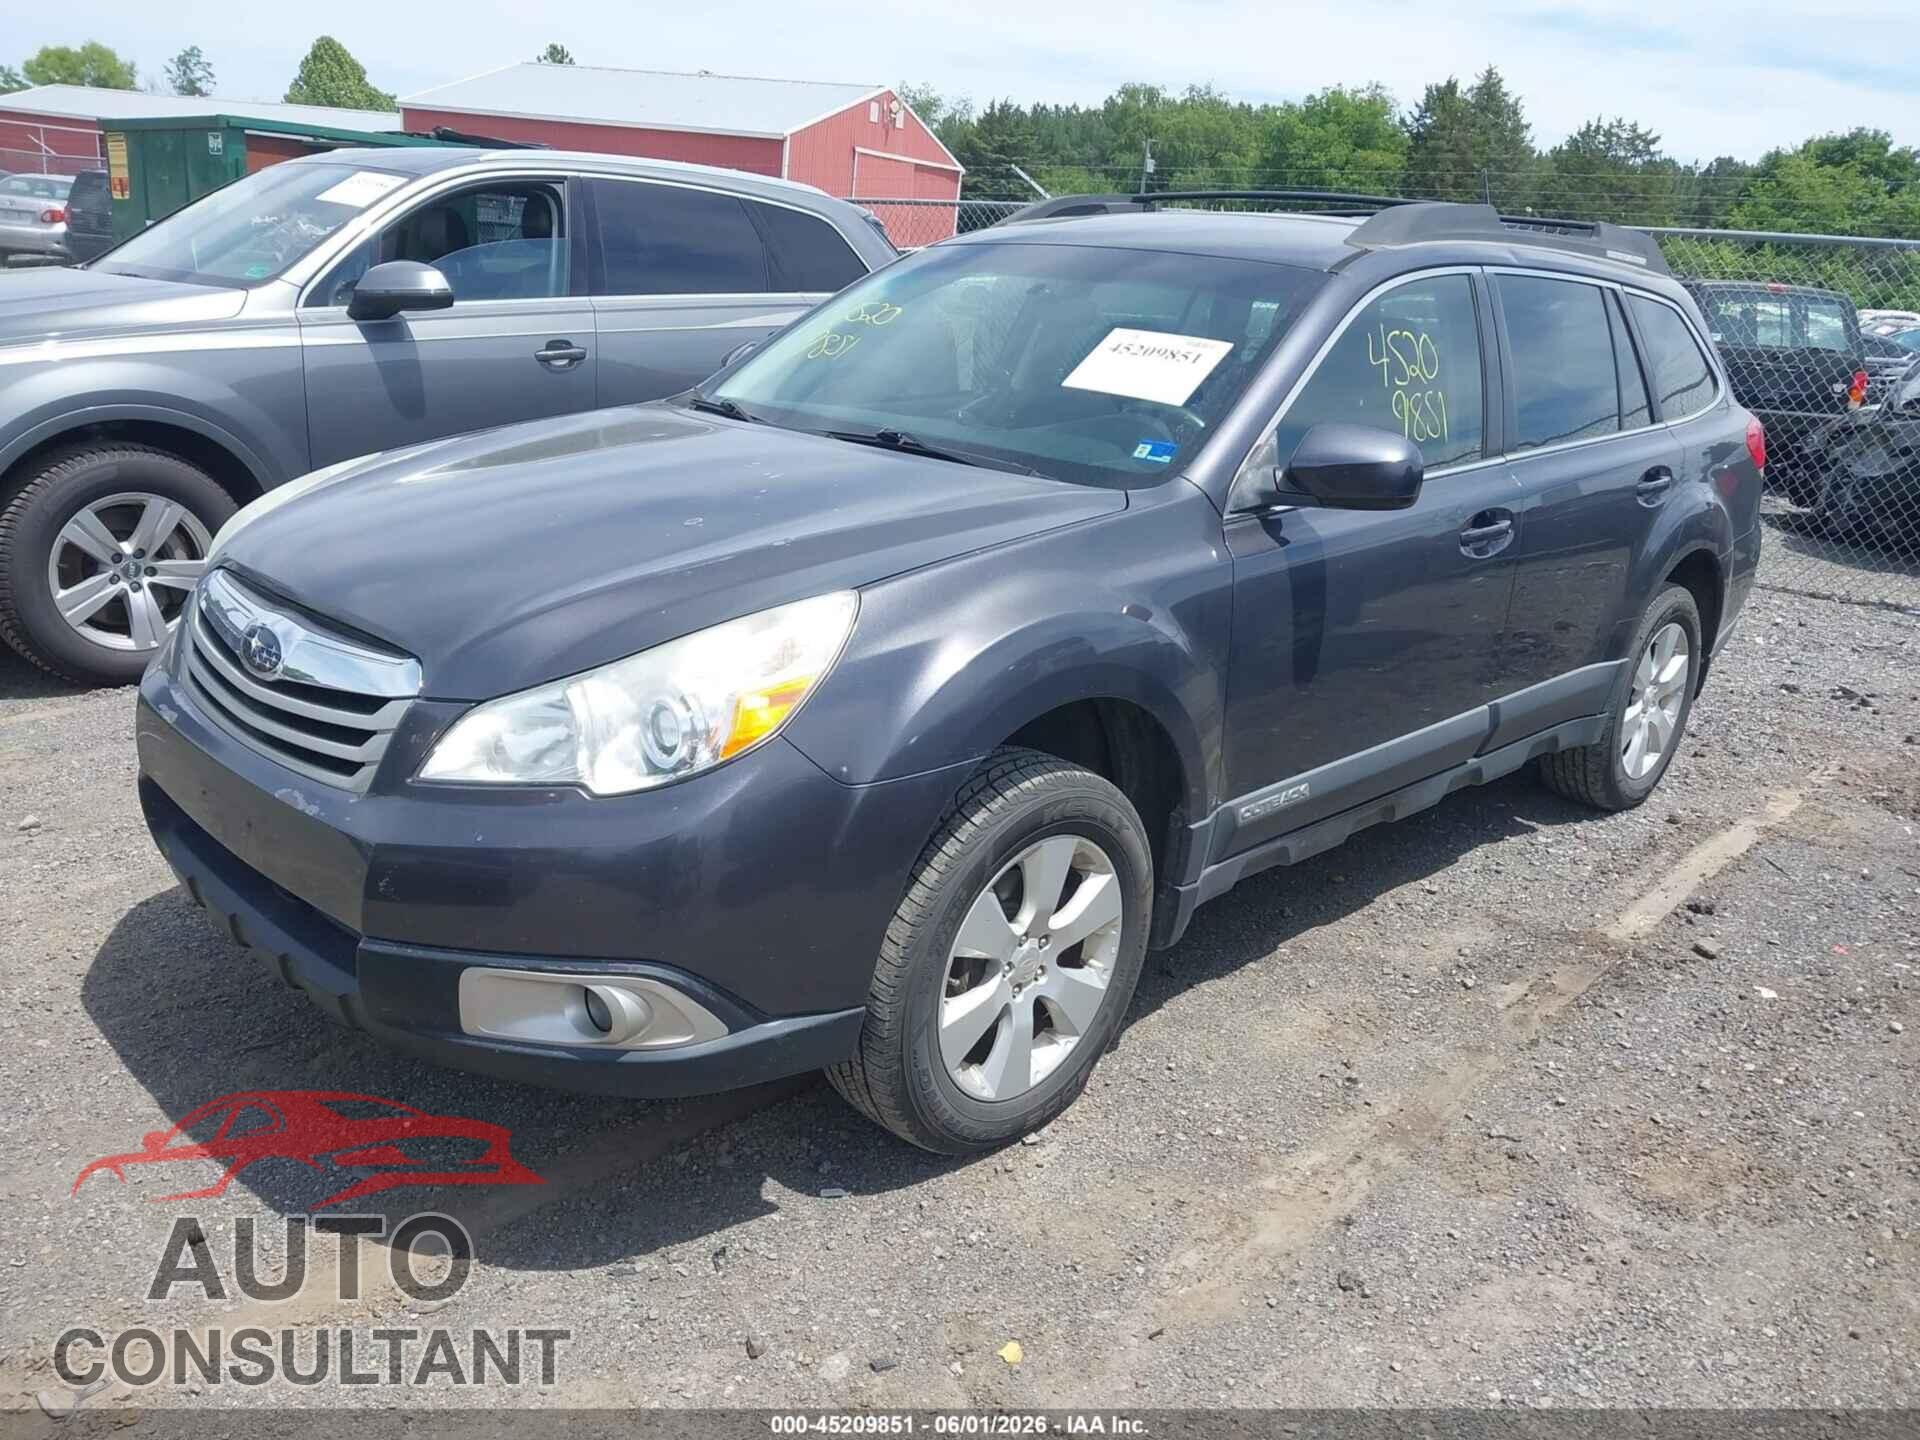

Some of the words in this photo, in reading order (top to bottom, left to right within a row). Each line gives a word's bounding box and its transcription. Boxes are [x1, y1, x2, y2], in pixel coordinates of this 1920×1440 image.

[1108, 341, 1203, 364] 45209851
[1367, 323, 1439, 388] 4520
[1391, 390, 1449, 443] 9851
